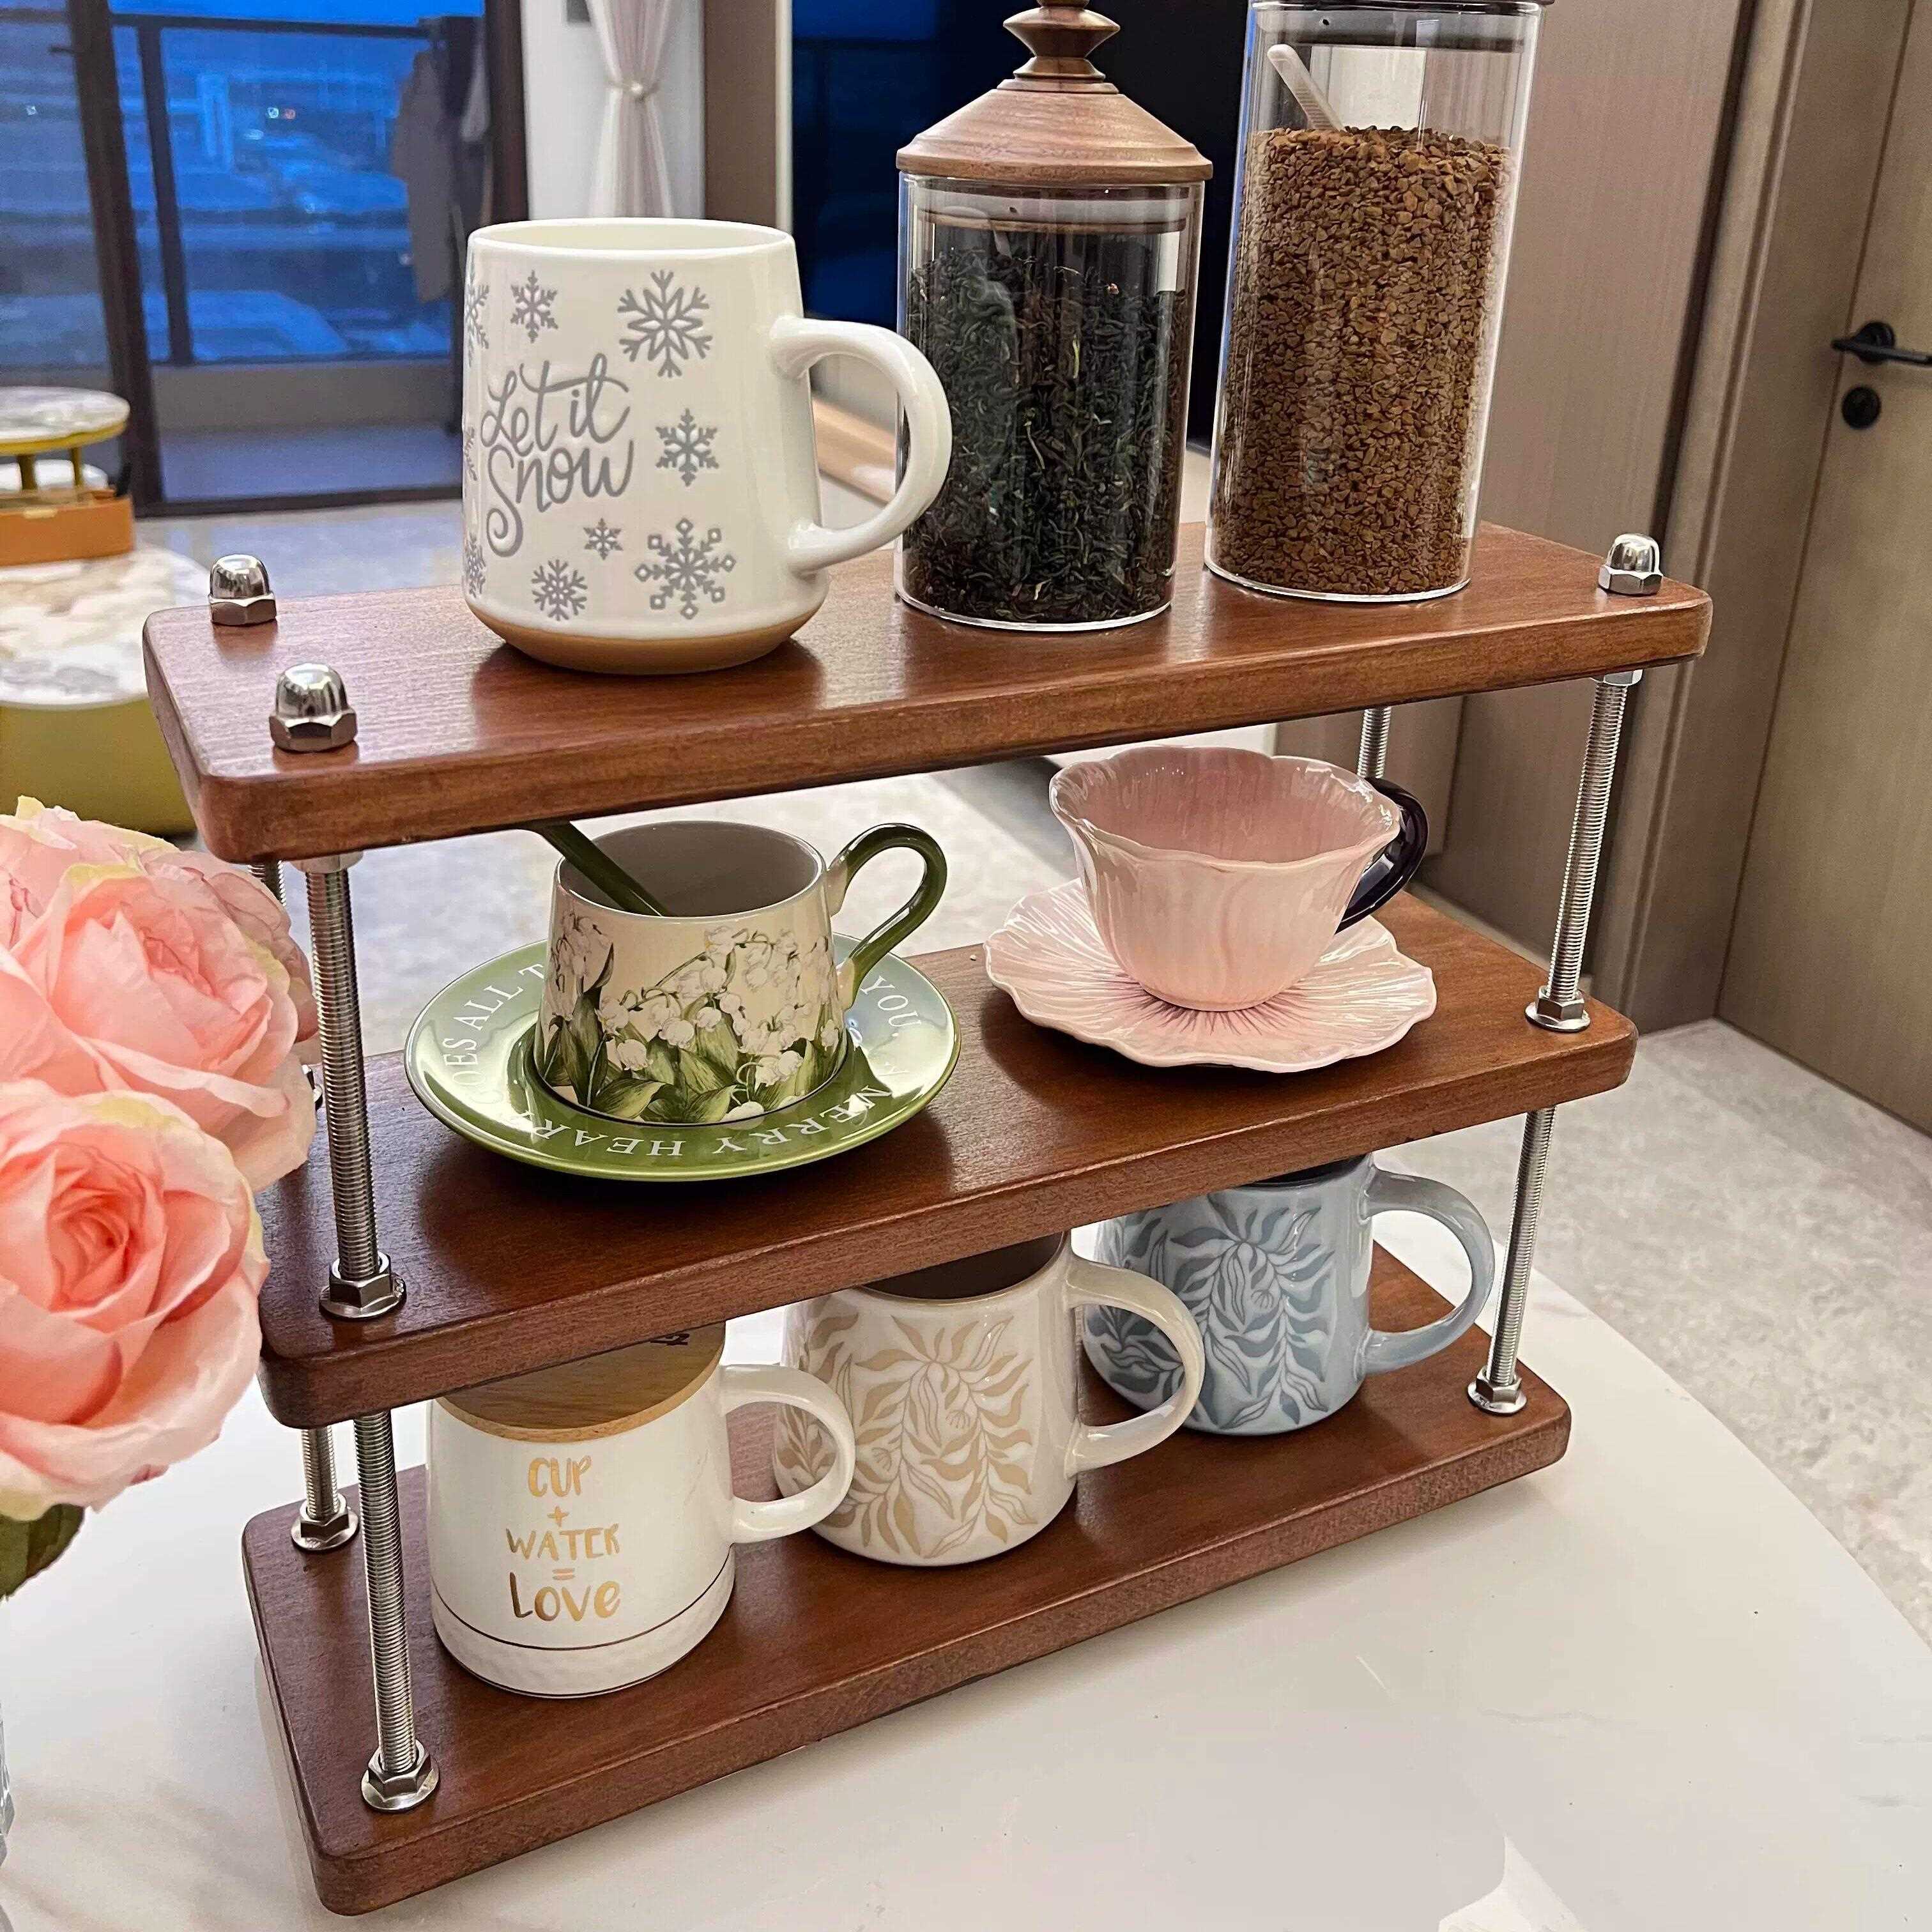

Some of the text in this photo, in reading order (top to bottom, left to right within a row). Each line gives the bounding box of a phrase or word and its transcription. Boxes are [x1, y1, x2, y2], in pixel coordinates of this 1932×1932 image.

[480, 353, 631, 457] Let it
[486, 440, 634, 557] Snow
[453, 985, 525, 1031] ALL
[712, 1084, 894, 1156] MERRY
[527, 1455, 592, 1498] CUP
